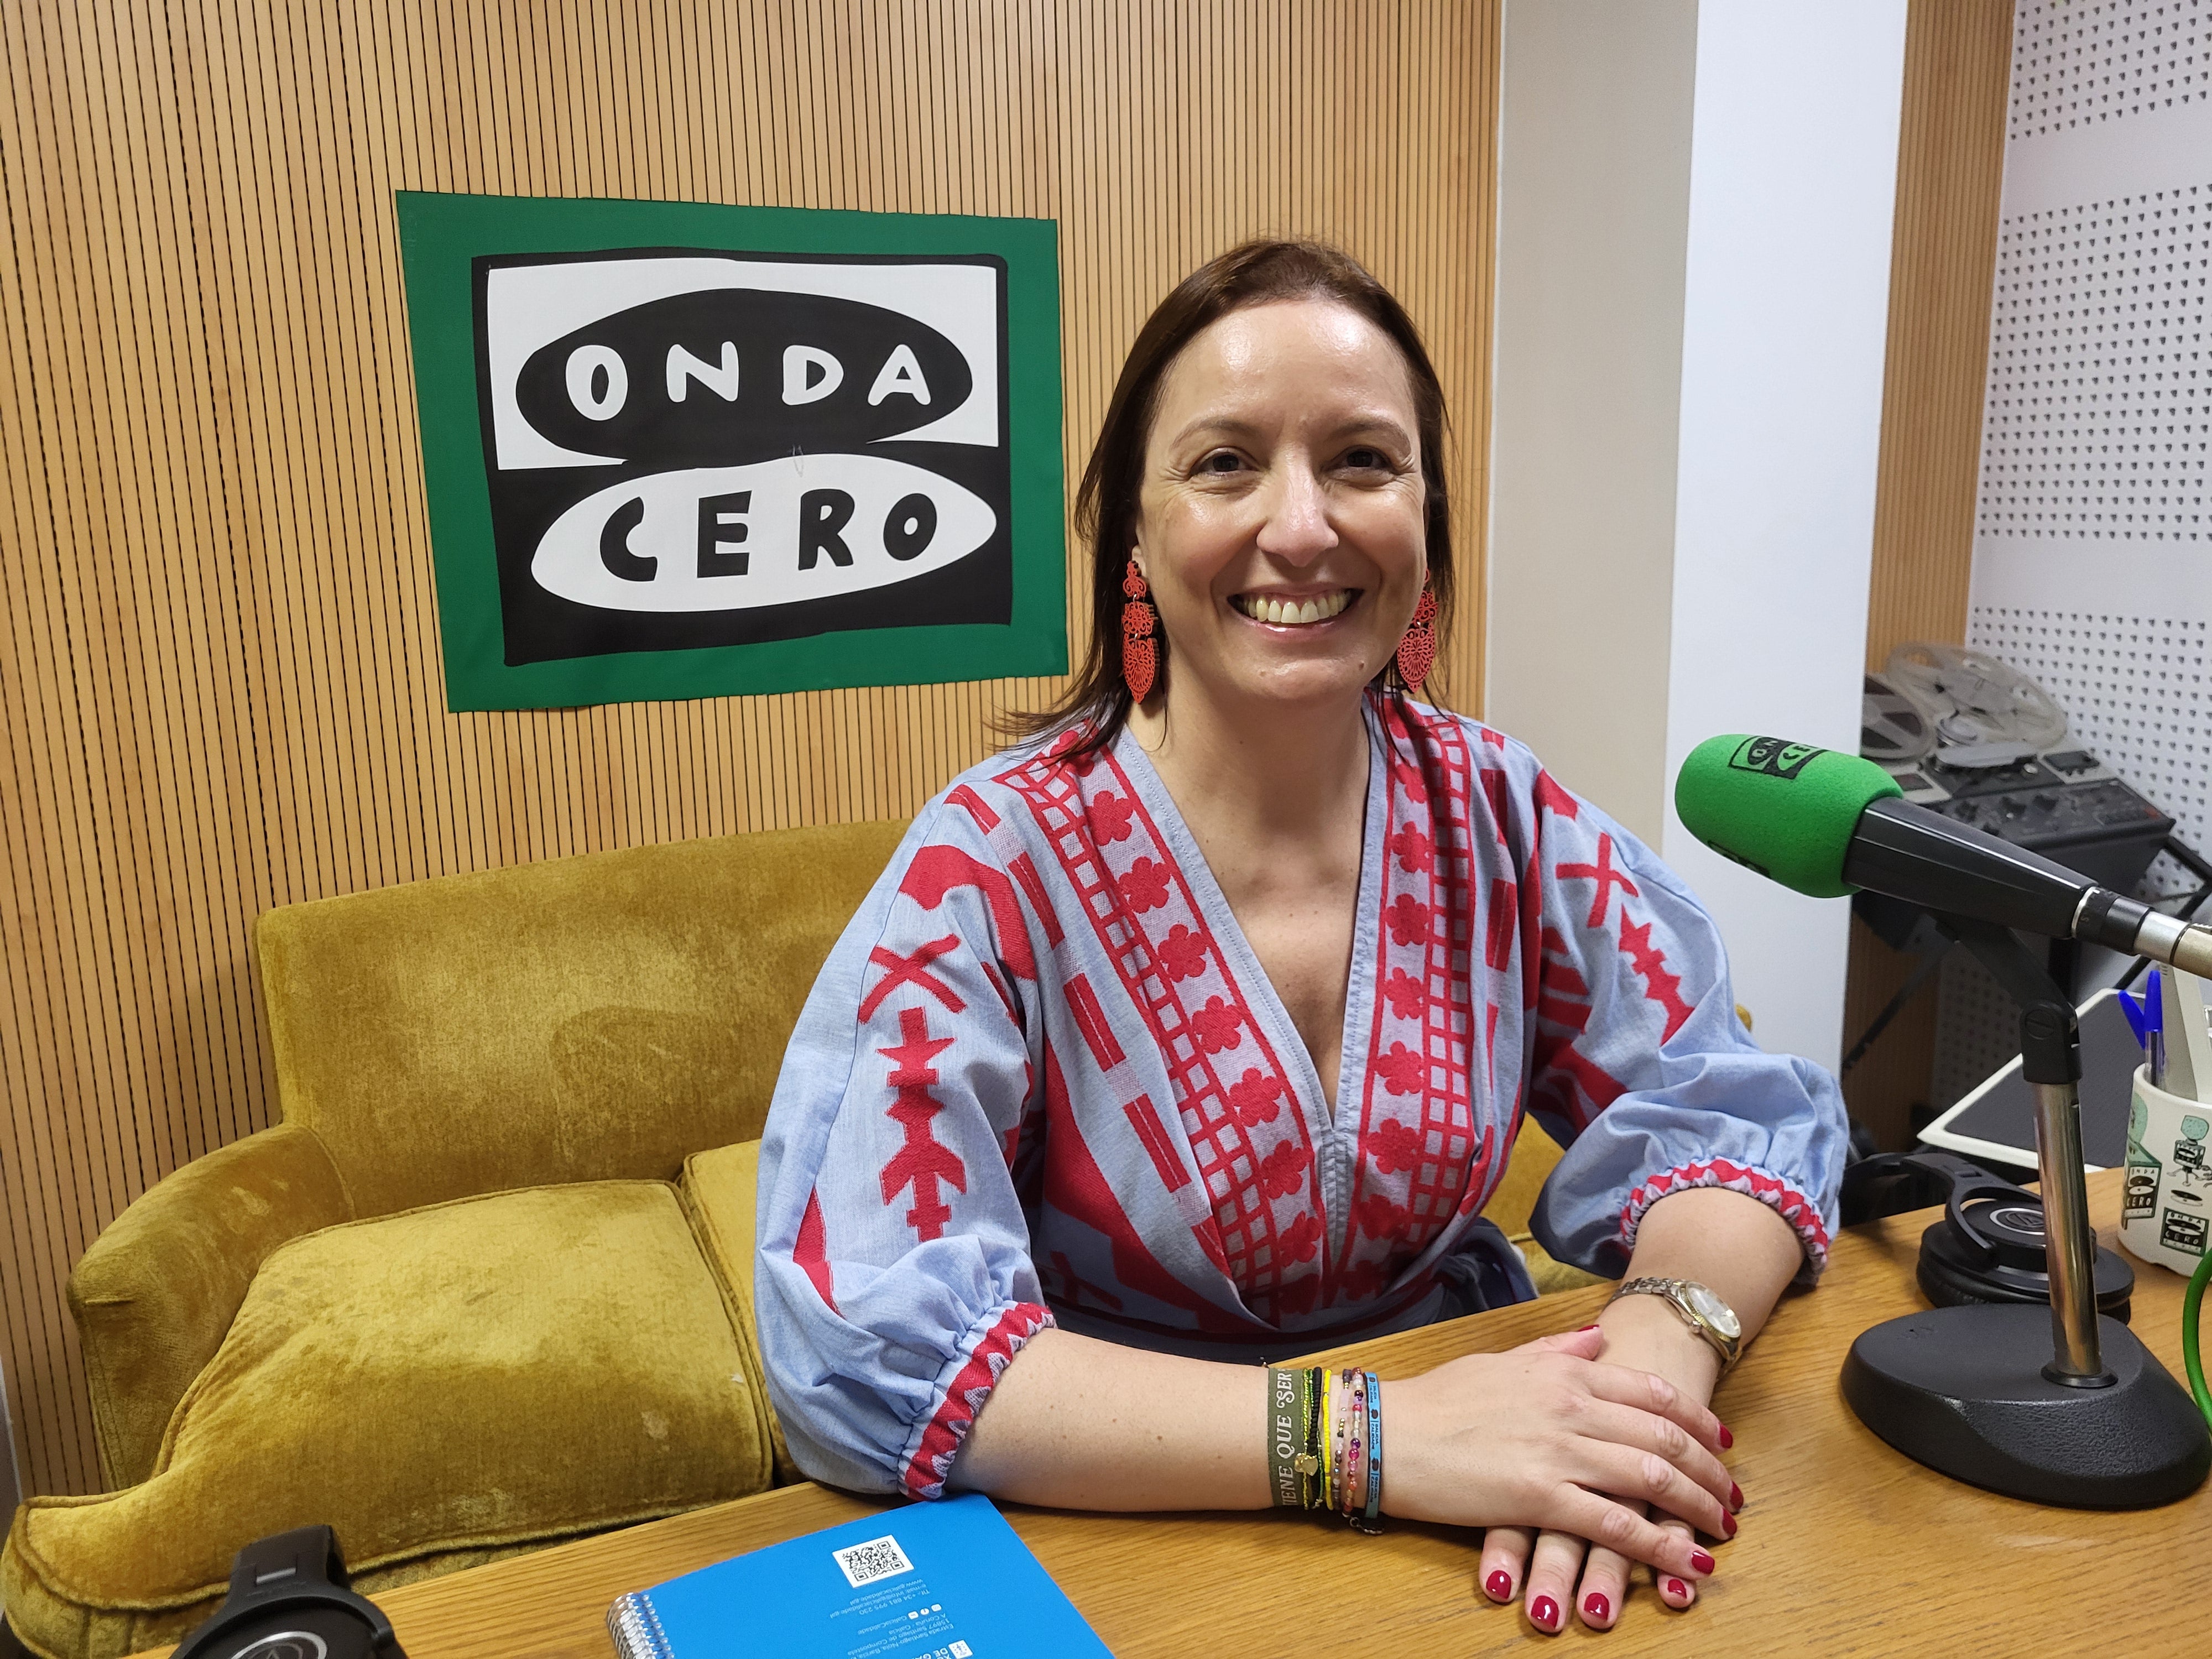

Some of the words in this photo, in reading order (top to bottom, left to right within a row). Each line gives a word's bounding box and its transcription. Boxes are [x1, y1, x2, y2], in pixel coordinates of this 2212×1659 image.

[565, 341, 932, 421] ONDA
[599, 489, 938, 583] CERO
[1276, 1373, 1295, 1408] SER
[1276, 1415, 1295, 1459] QUE
[874, 1602, 888, 1610] 995
[889, 1597, 902, 1606] 881
[859, 1606, 873, 1615] 230
[857, 1615, 907, 1635] GaliciaCalidade
[888, 1625, 911, 1635] Galicia
[928, 1623, 954, 1635] Estrada
[929, 1618, 950, 1630] 15897
[898, 1626, 927, 1638] Santiago
[847, 1639, 888, 1656] Compostela
